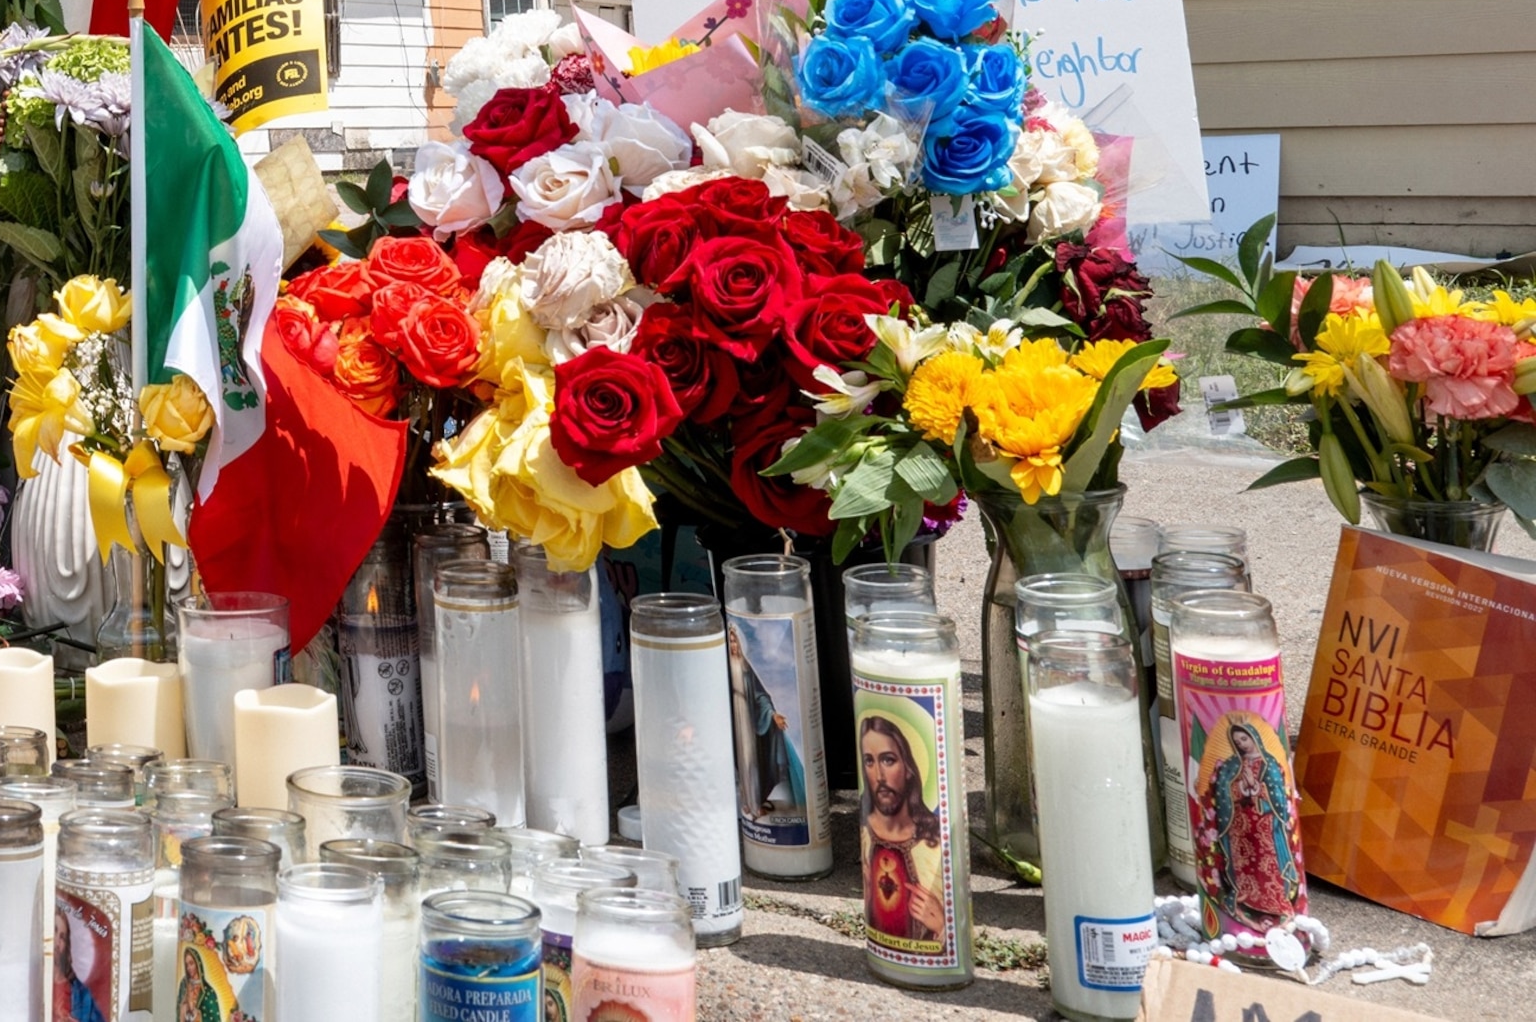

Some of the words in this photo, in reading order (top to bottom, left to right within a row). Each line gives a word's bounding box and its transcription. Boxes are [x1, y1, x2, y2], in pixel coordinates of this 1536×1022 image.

[1028, 36, 1144, 109] eighbor
[227, 85, 264, 111] eb.org
[1375, 565, 1408, 582] NUEVA
[1411, 576, 1455, 596] VERSIÓN
[1463, 601, 1484, 614] 2022
[1338, 610, 1401, 661] NVI
[1181, 659, 1209, 675] Virgin
[1211, 665, 1224, 676] of
[1226, 662, 1277, 677] Guadalupe
[1332, 648, 1428, 706] SANTA
[1321, 677, 1456, 760] BIBLIA
[1317, 717, 1357, 744] LETRA
[1360, 733, 1419, 765] GRANDE
[879, 934, 901, 948] Heart
[902, 940, 912, 948] of
[914, 941, 940, 951] Jesus
[1122, 929, 1152, 943] MAGIC
[465, 987, 533, 1008] PREPARADA
[460, 1007, 510, 1022] CANDLE
